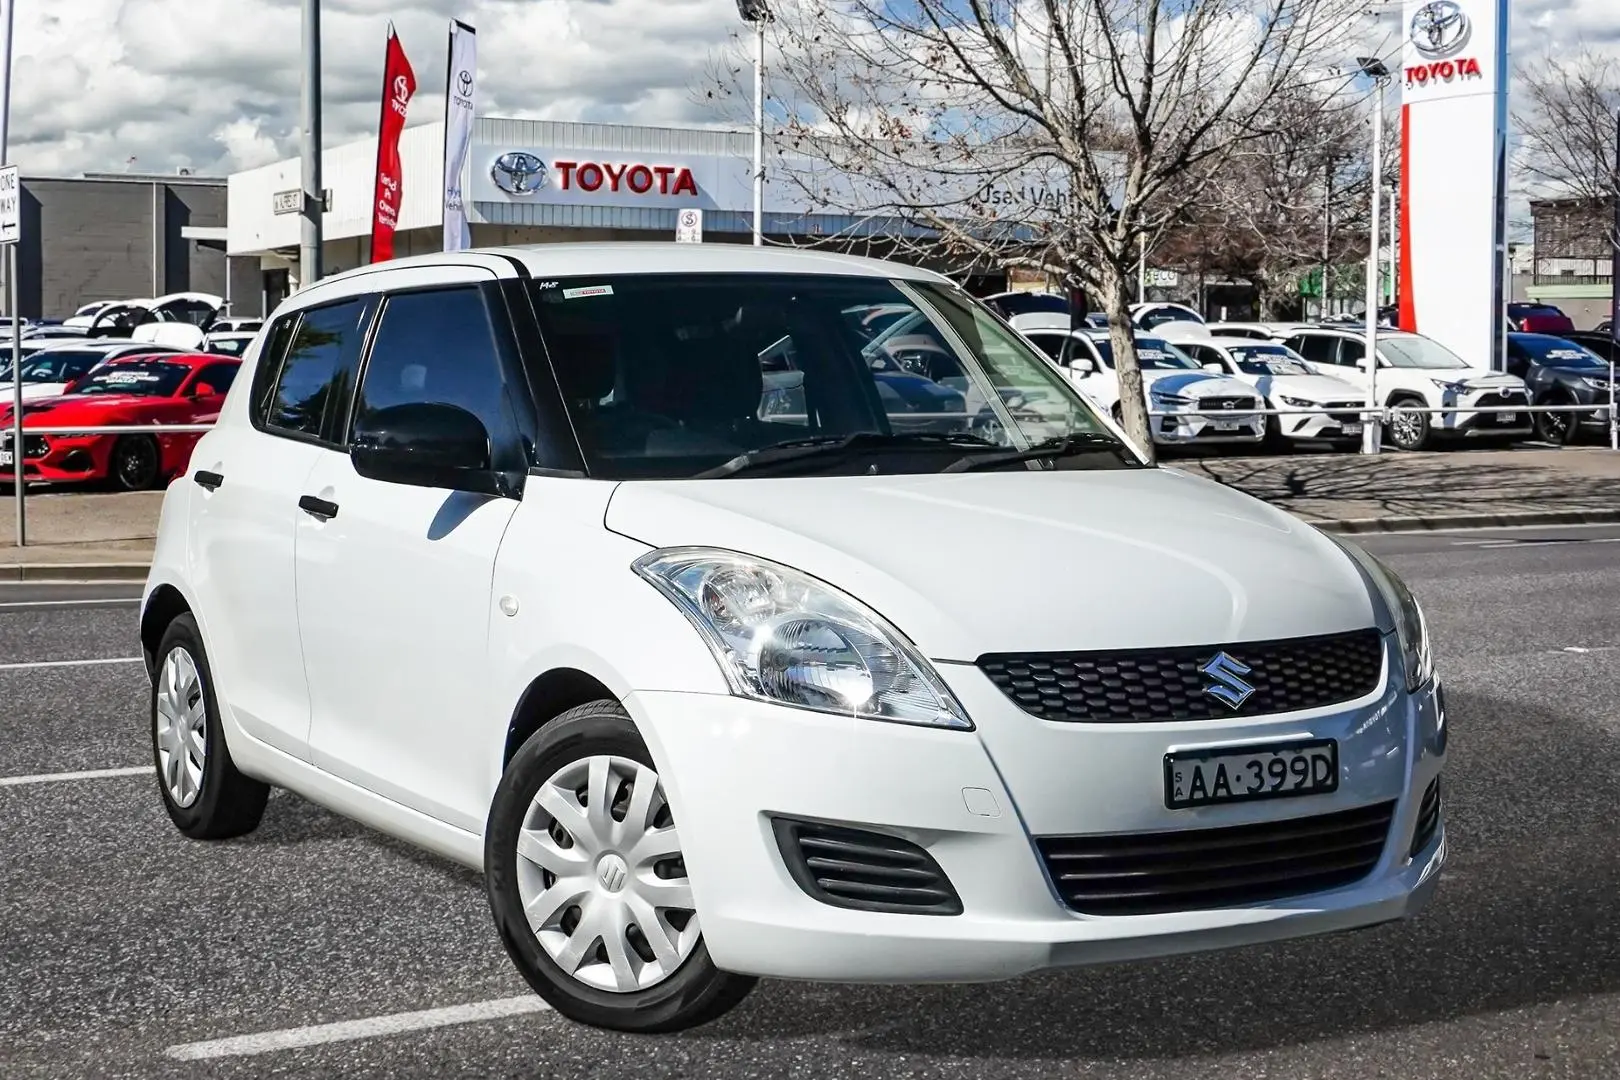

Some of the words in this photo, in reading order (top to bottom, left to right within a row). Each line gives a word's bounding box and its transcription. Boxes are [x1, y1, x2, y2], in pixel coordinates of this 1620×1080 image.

[1404, 58, 1480, 83] TOYOTA
[0, 173, 15, 191] ONE
[554, 161, 698, 196] TOYOTA
[0, 196, 16, 213] WAY
